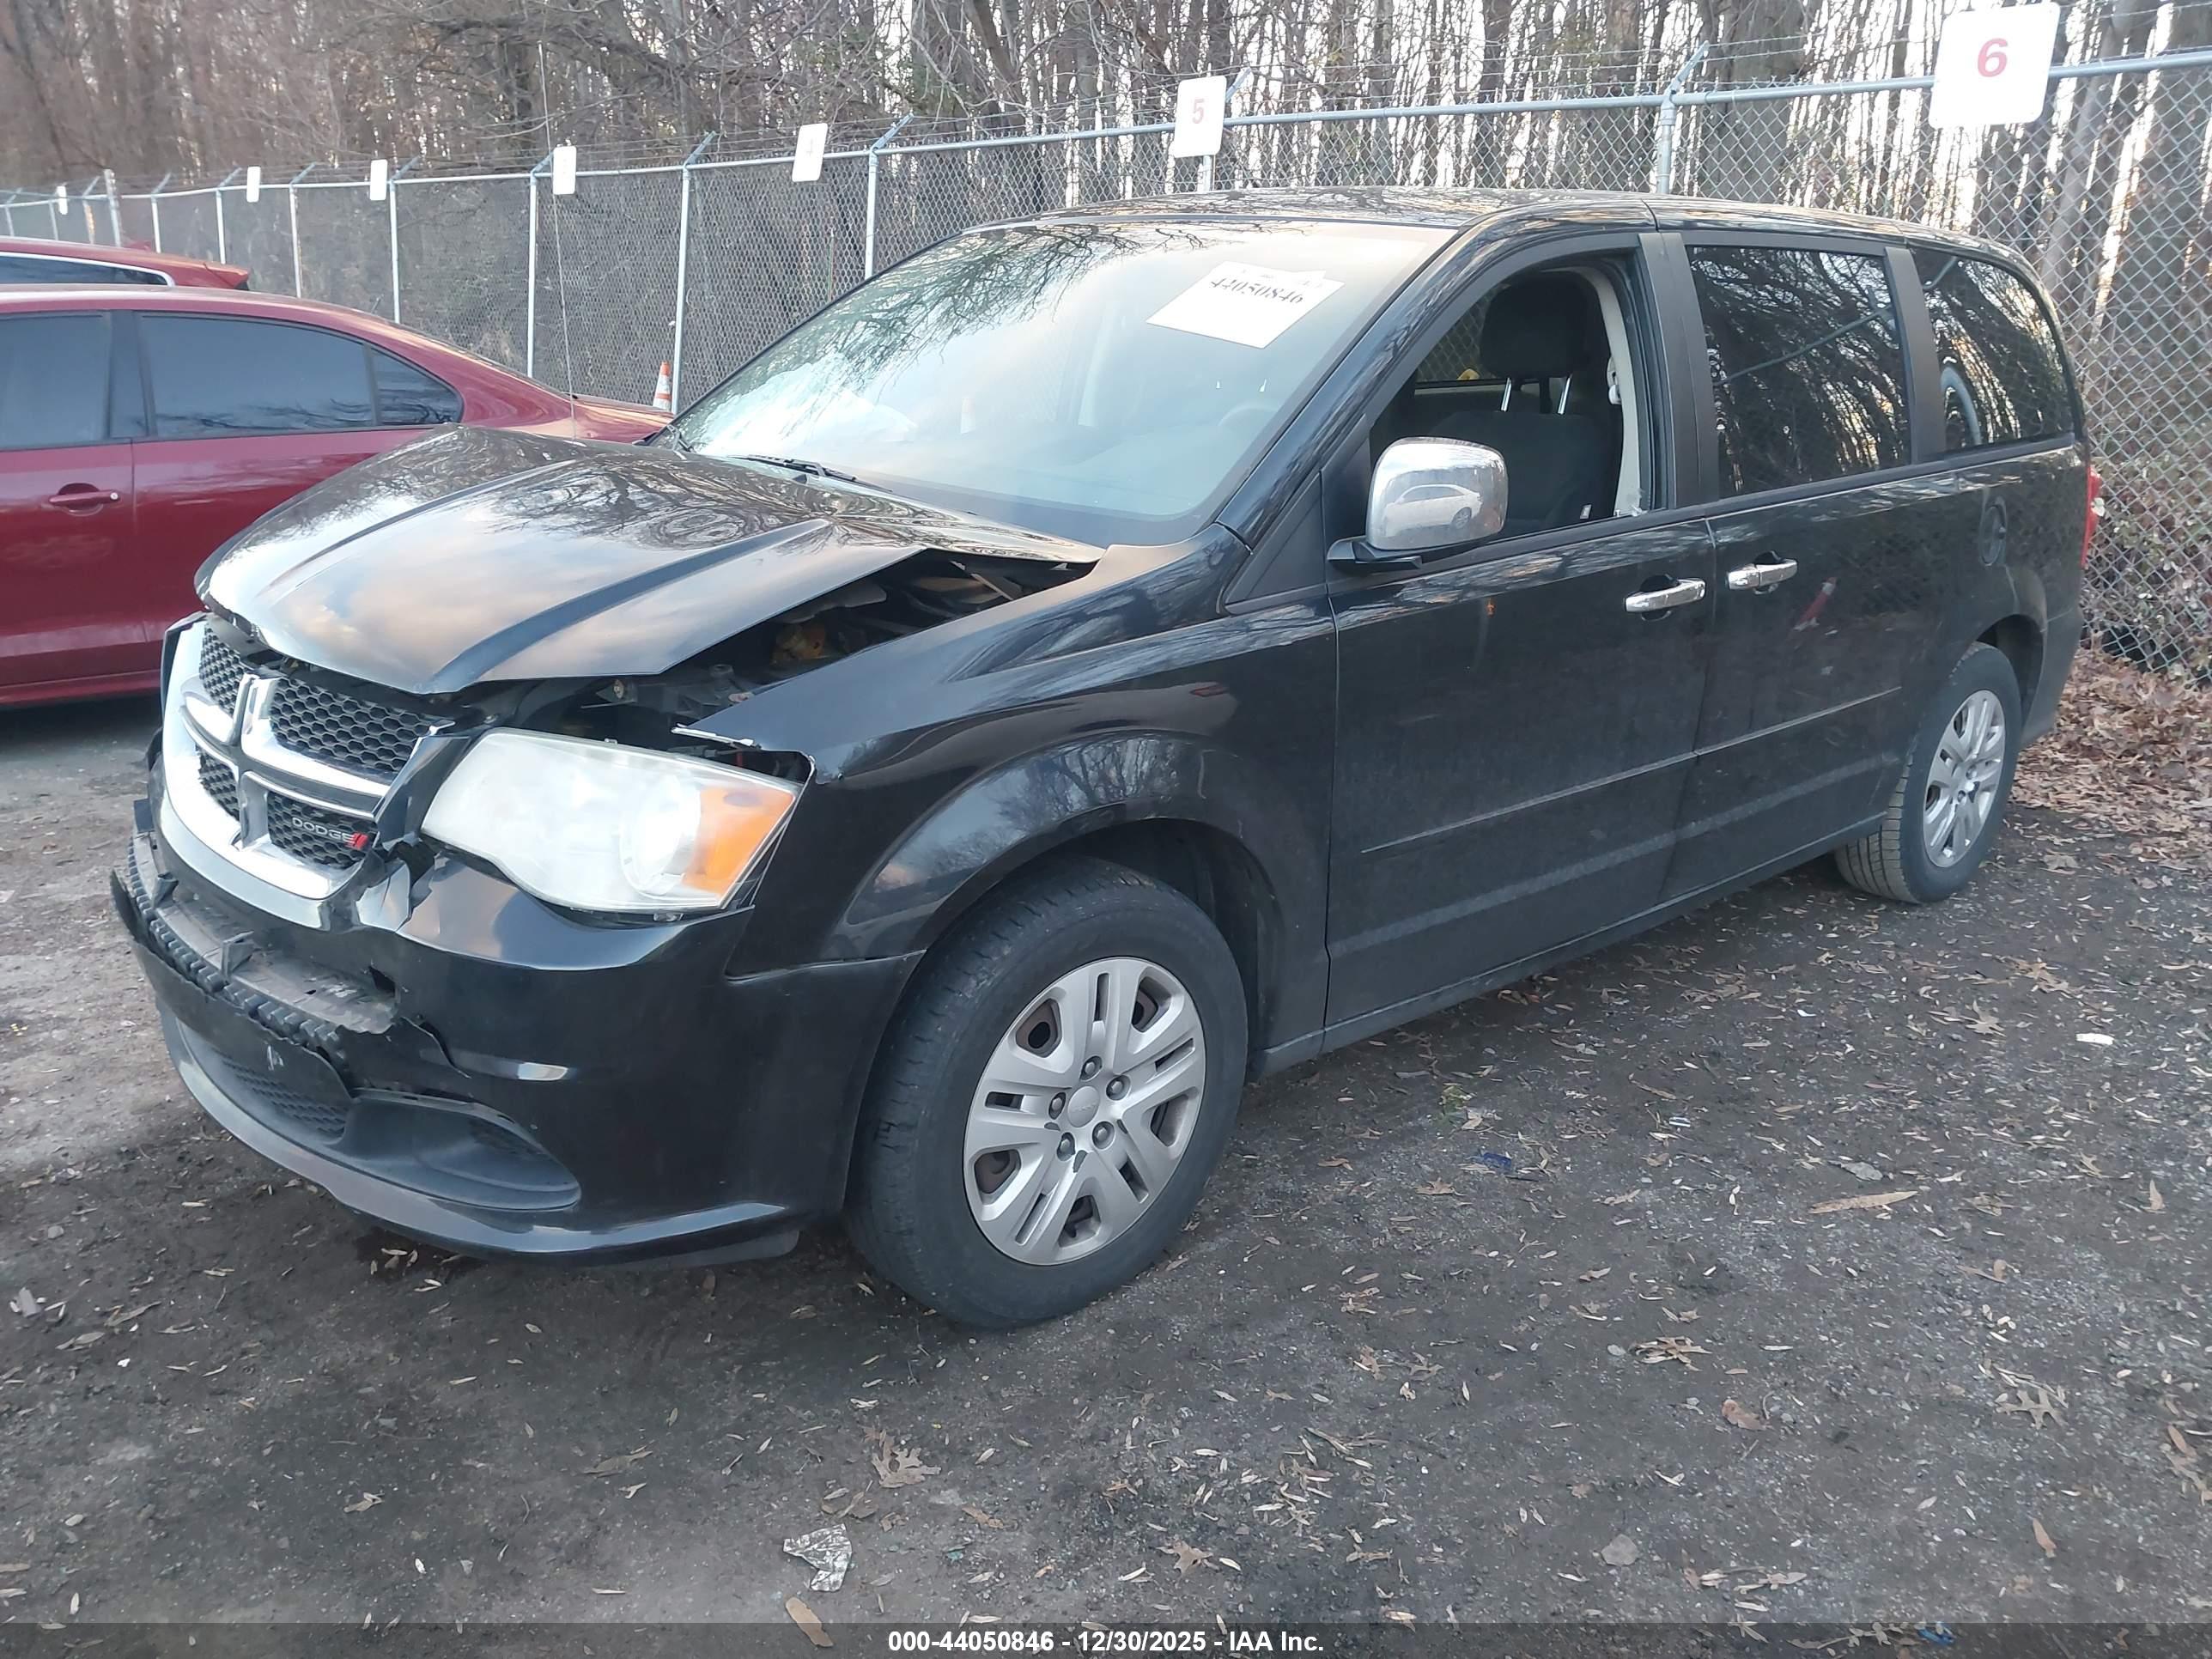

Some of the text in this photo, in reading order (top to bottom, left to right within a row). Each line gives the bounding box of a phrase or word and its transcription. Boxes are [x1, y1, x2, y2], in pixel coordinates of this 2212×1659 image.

[1977, 38, 2008, 77] 6
[1192, 98, 1205, 124] 5
[292, 817, 355, 844] DODGE
